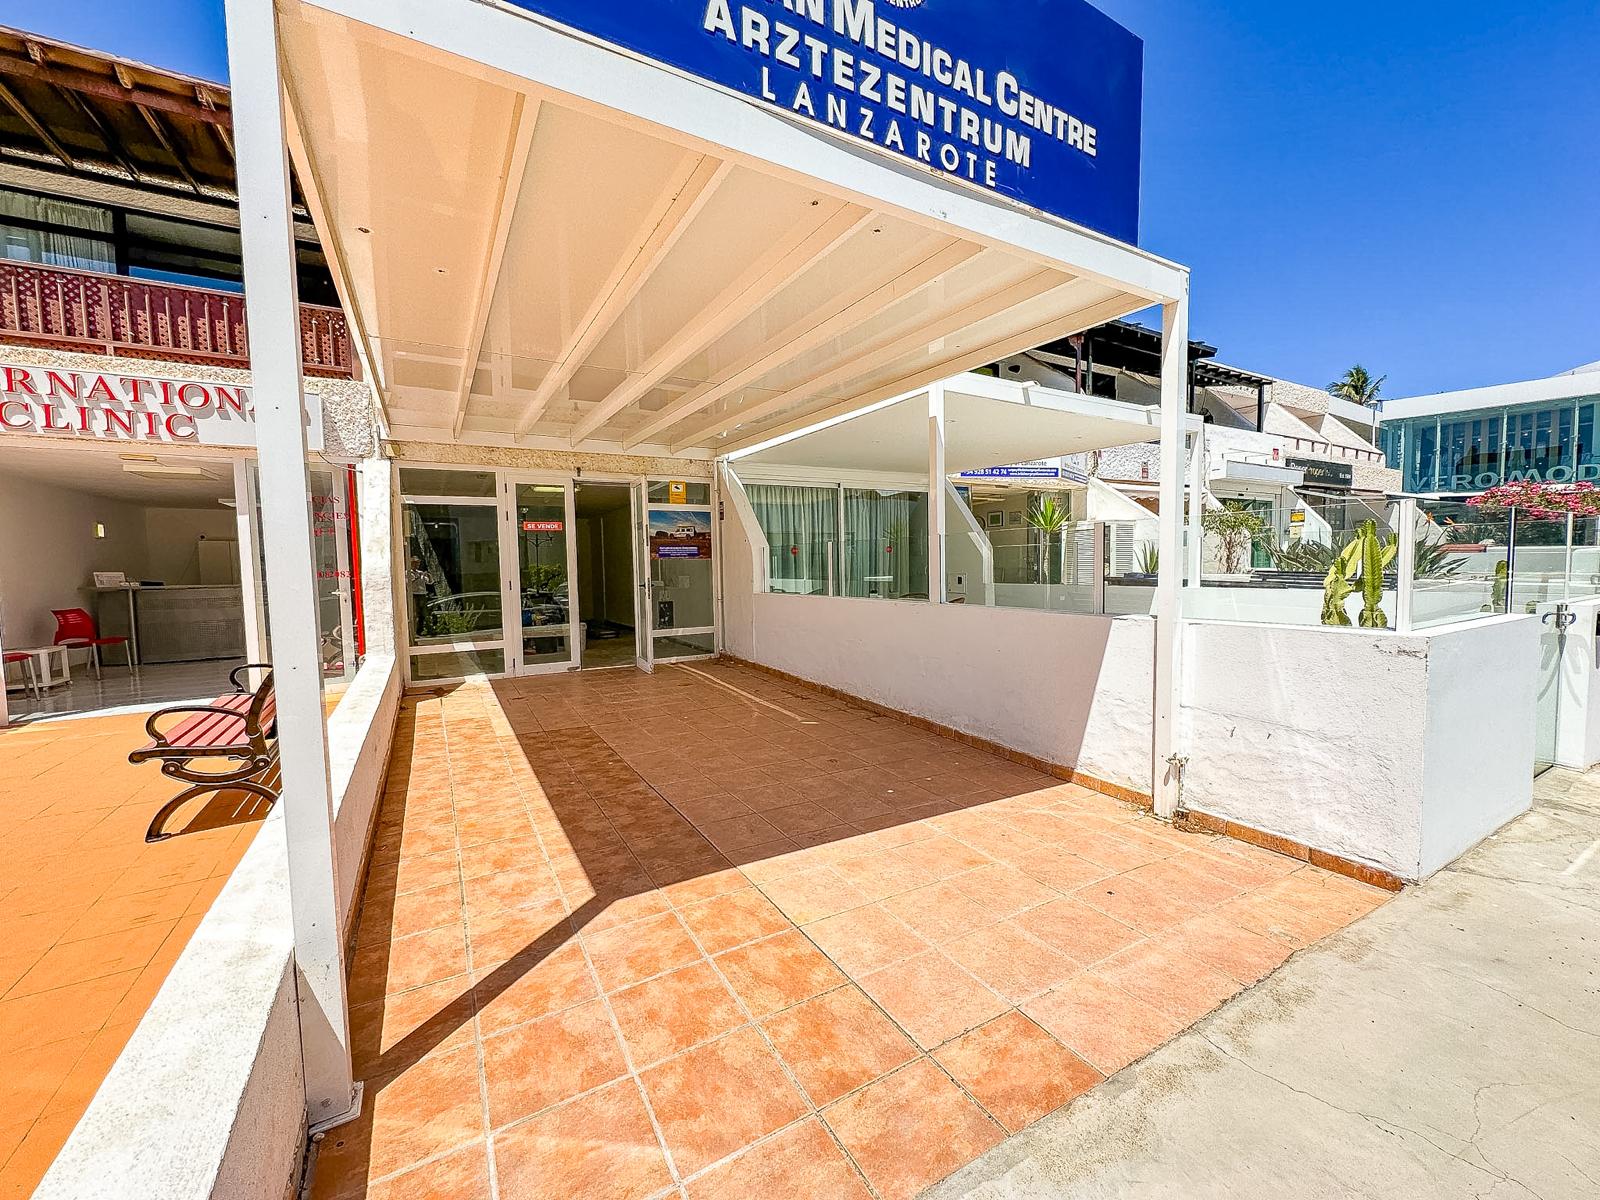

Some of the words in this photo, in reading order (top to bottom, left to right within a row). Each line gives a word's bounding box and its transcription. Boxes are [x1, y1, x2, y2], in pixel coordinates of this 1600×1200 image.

[703, 0, 1031, 168] ARZTEZENTRUM
[833, 0, 992, 107] MEDICAL
[996, 71, 1097, 157] CENTRE
[762, 67, 996, 187] LANZAROTE
[0, 400, 197, 439] CLINIC
[2, 366, 256, 414] RNATION
[1410, 471, 1500, 494] VERO
